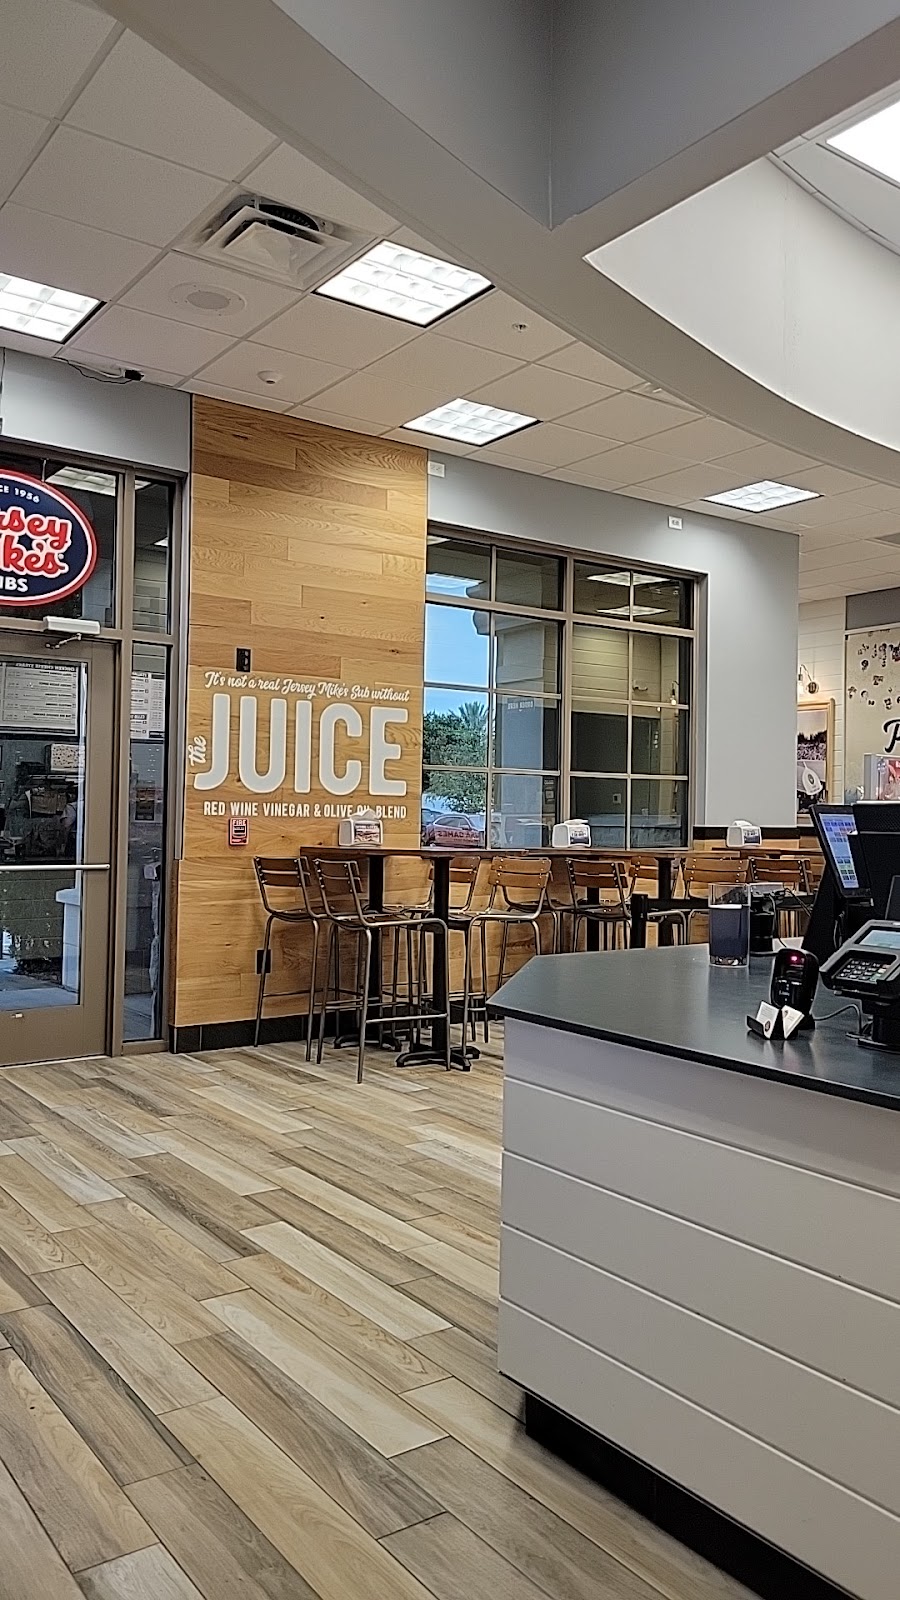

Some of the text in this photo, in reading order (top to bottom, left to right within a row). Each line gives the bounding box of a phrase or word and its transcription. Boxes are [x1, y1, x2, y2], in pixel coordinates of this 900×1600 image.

[14, 487, 40, 503] 1956
[204, 671, 410, 702] It's not a real Jersey Mike's Sub without
[188, 735, 207, 767] the
[193, 693, 408, 796] JUICE
[203, 801, 226, 816] RED
[231, 802, 258, 817] WINE
[263, 803, 310, 818] VINEGAR
[314, 804, 322, 818] &
[324, 804, 353, 818] OLIVE
[376, 805, 407, 819] BLEND
